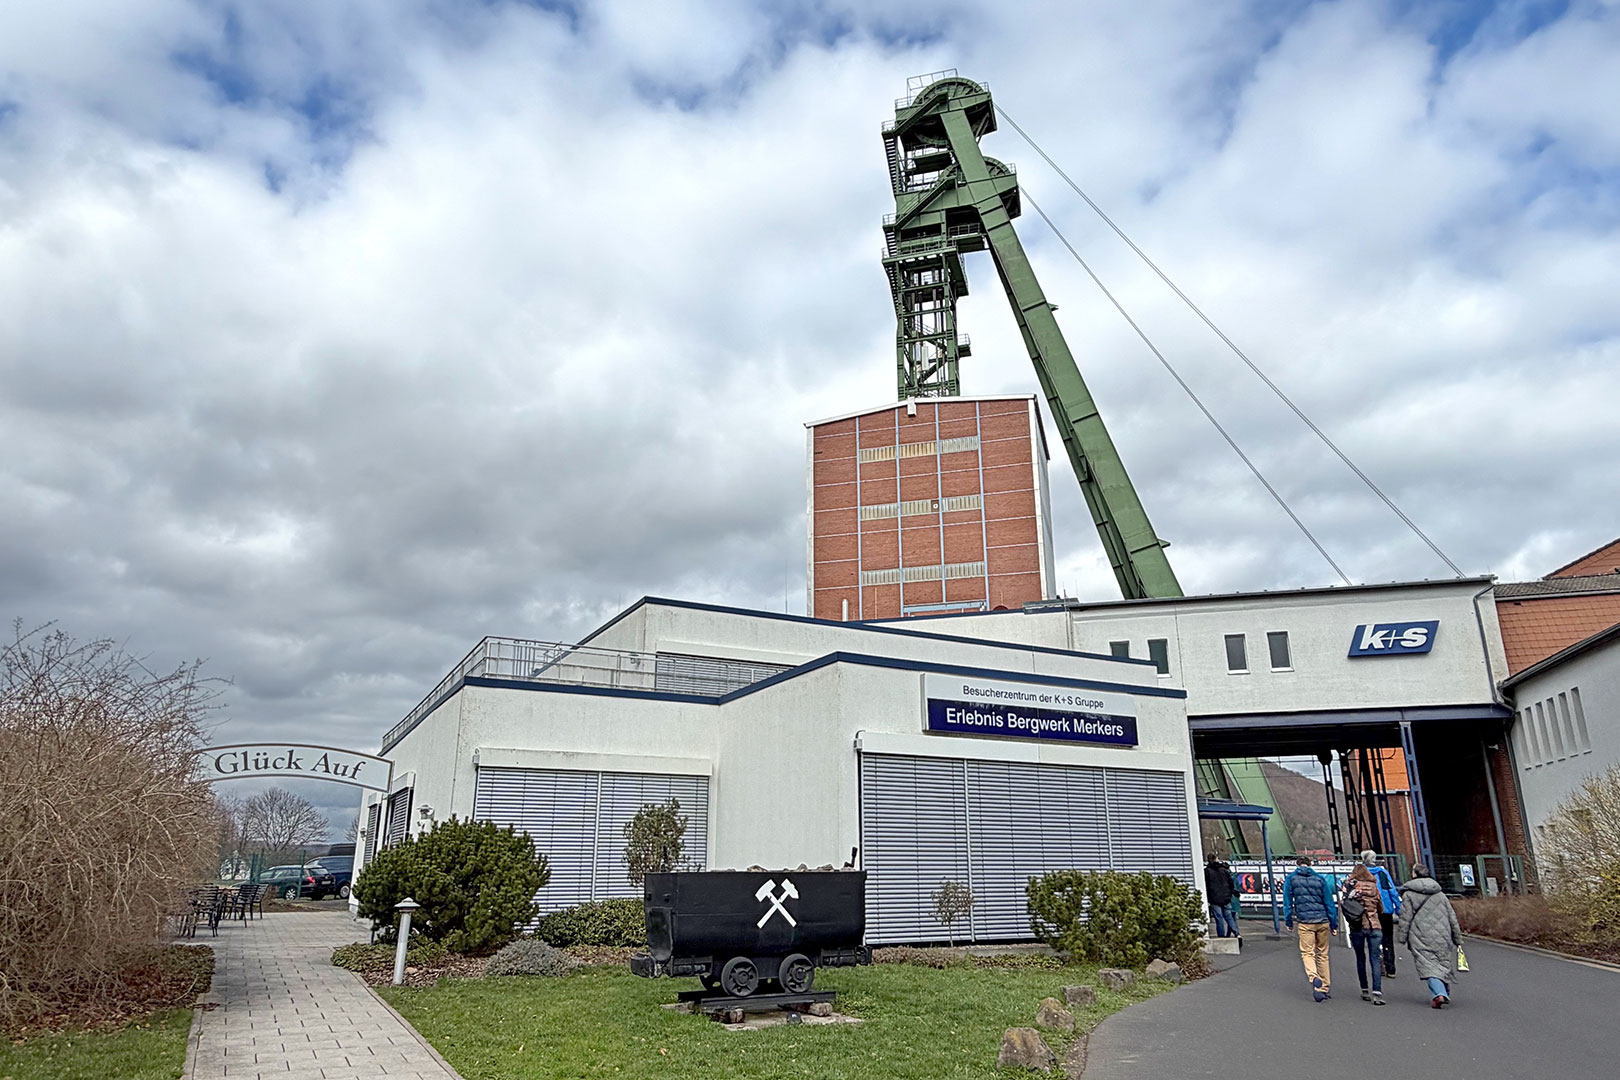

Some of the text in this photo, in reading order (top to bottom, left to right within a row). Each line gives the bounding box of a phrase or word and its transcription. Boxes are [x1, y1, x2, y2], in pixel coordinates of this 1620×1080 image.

[963, 685, 1104, 709] Besucherzentrum der K+S Gruppe
[946, 708, 1124, 737] Erlebnis Bergwerk Merkers
[214, 749, 366, 780] Glück Auf
